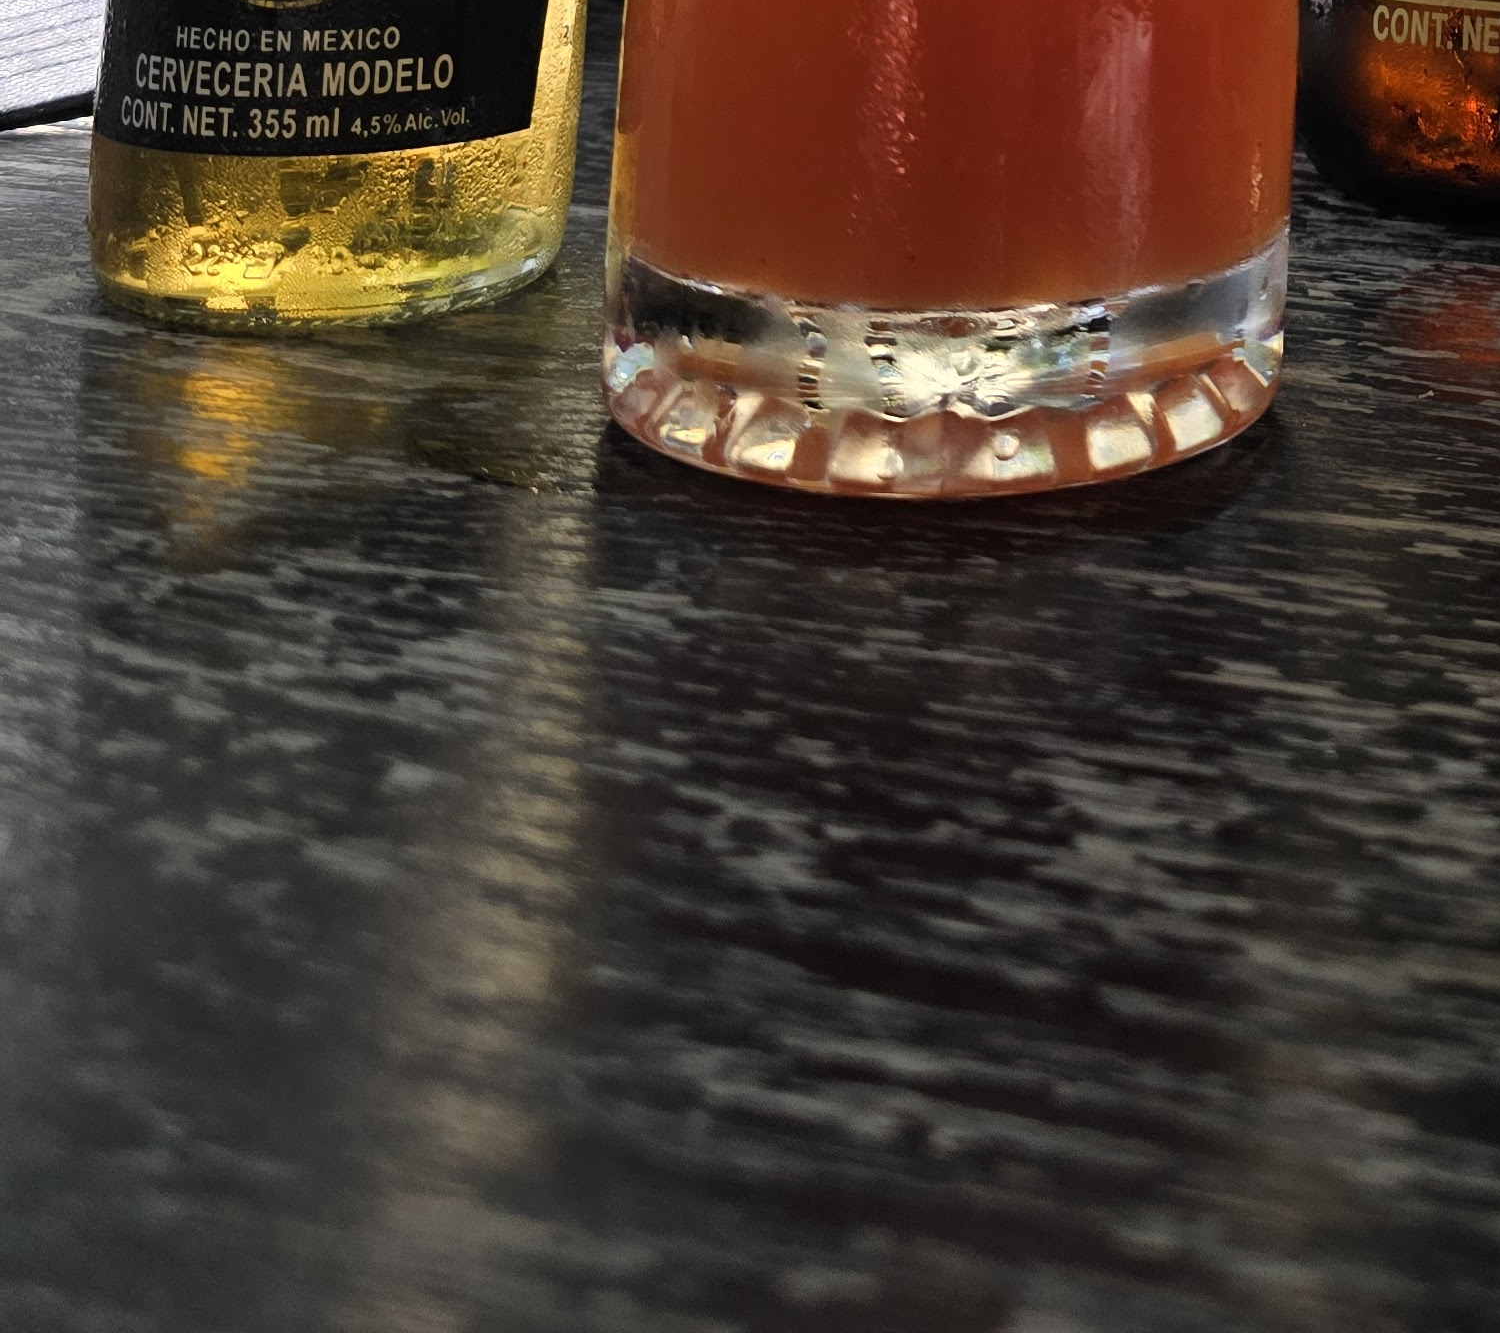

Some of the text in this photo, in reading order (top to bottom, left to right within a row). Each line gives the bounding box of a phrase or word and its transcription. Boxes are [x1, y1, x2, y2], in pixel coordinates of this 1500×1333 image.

[175, 25, 401, 52] HECHO EN MEXICO
[1372, 4, 1454, 51] CONT.
[136, 52, 454, 98] CERVECERIA MODELO
[121, 95, 175, 134] CONT.
[182, 104, 238, 138] NET.
[248, 108, 298, 139] 355
[305, 106, 340, 138] ml
